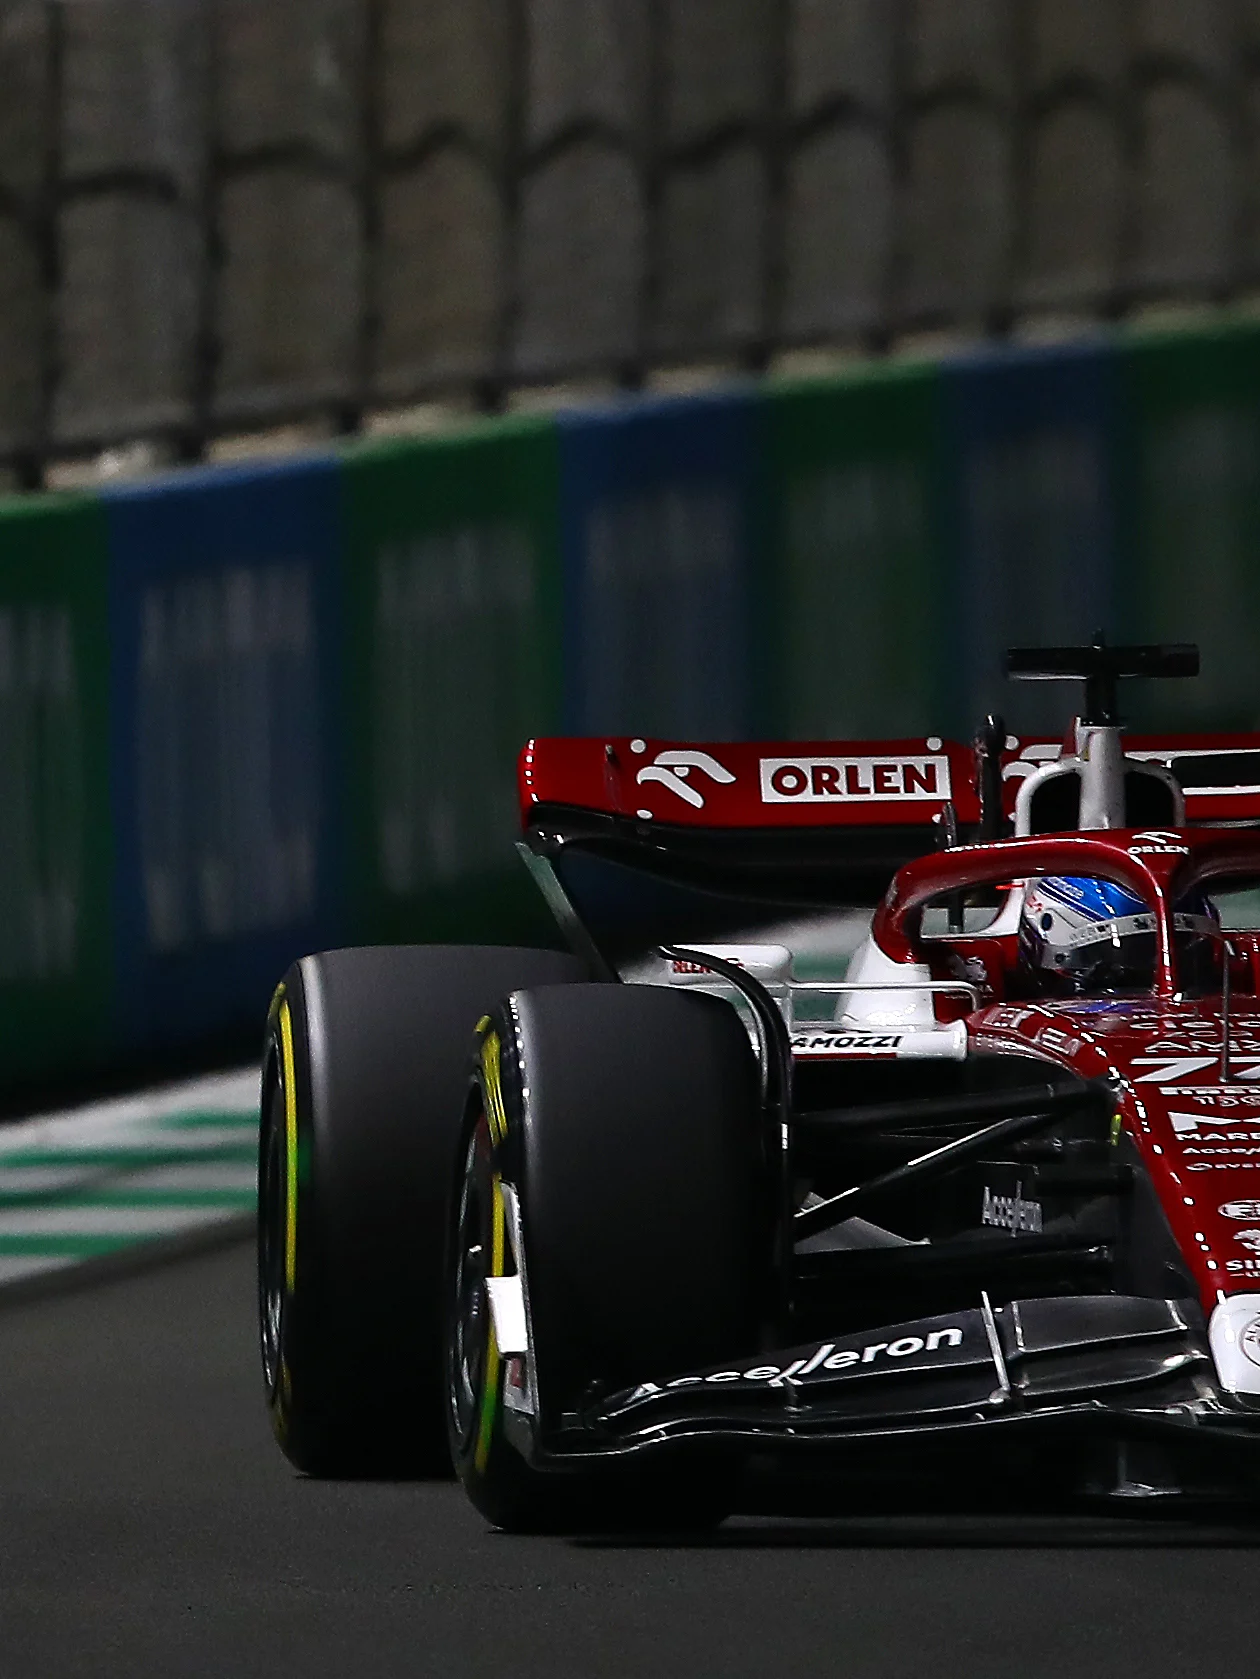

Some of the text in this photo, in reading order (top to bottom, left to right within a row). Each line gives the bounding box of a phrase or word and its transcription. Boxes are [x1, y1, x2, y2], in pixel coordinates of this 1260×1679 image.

[772, 763, 937, 796] ORLEN
[1127, 845, 1190, 855] ORLEN
[790, 1035, 903, 1048] AMOZZI
